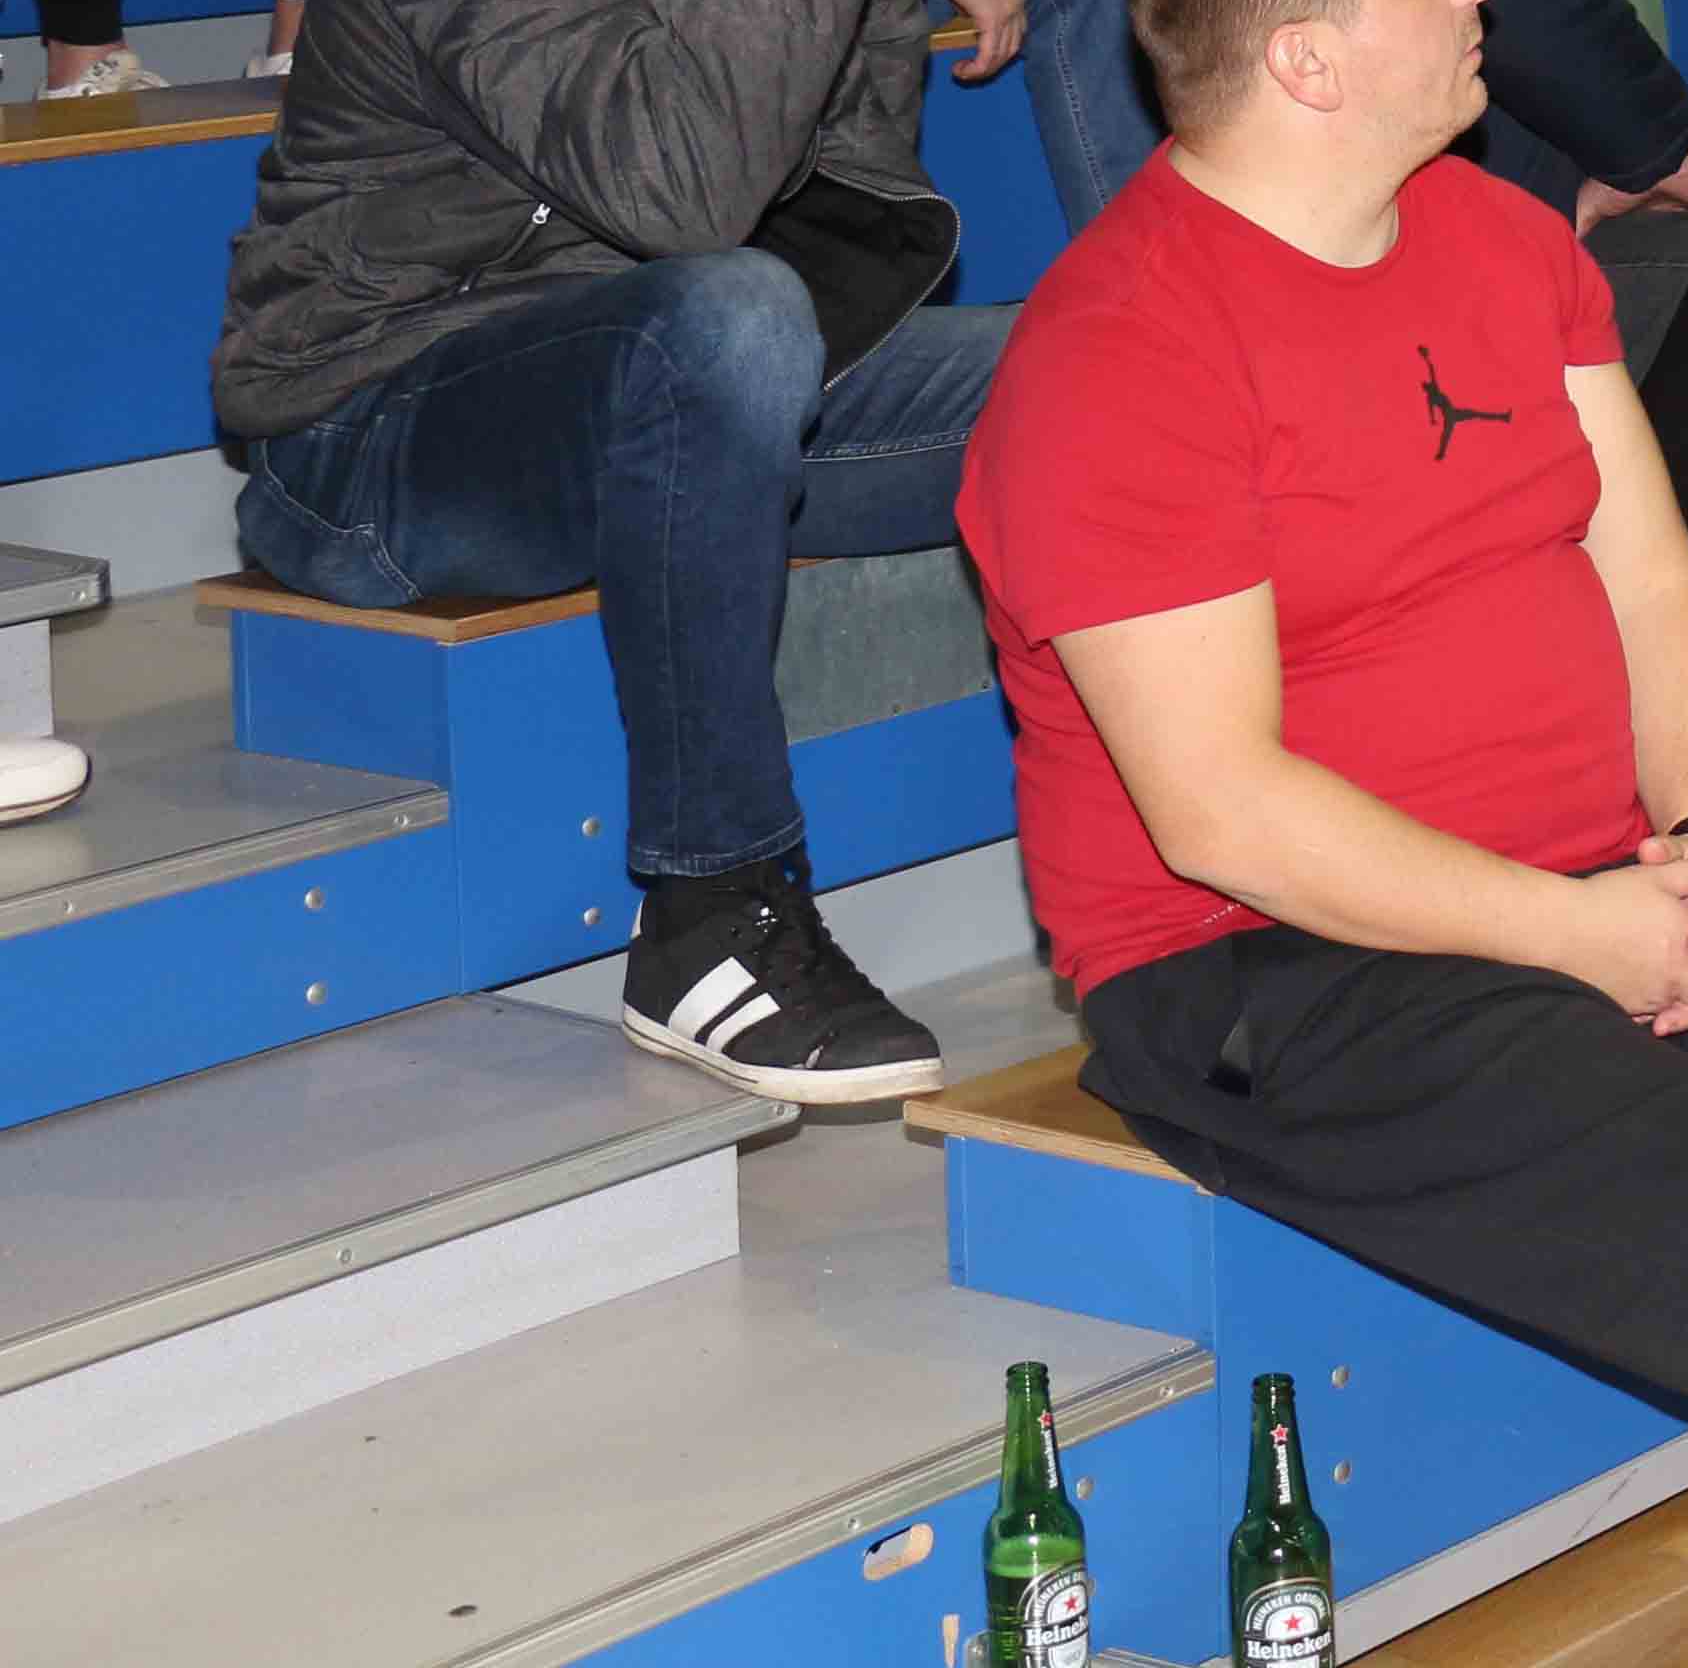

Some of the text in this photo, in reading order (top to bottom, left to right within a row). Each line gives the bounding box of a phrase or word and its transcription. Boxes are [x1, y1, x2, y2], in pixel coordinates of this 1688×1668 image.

[1276, 1443, 1293, 1505] Heineken
[1252, 1594, 1292, 1631] HEINEKEN
[1025, 1614, 1088, 1647] Heinek
[1247, 1631, 1332, 1661] Heineken
